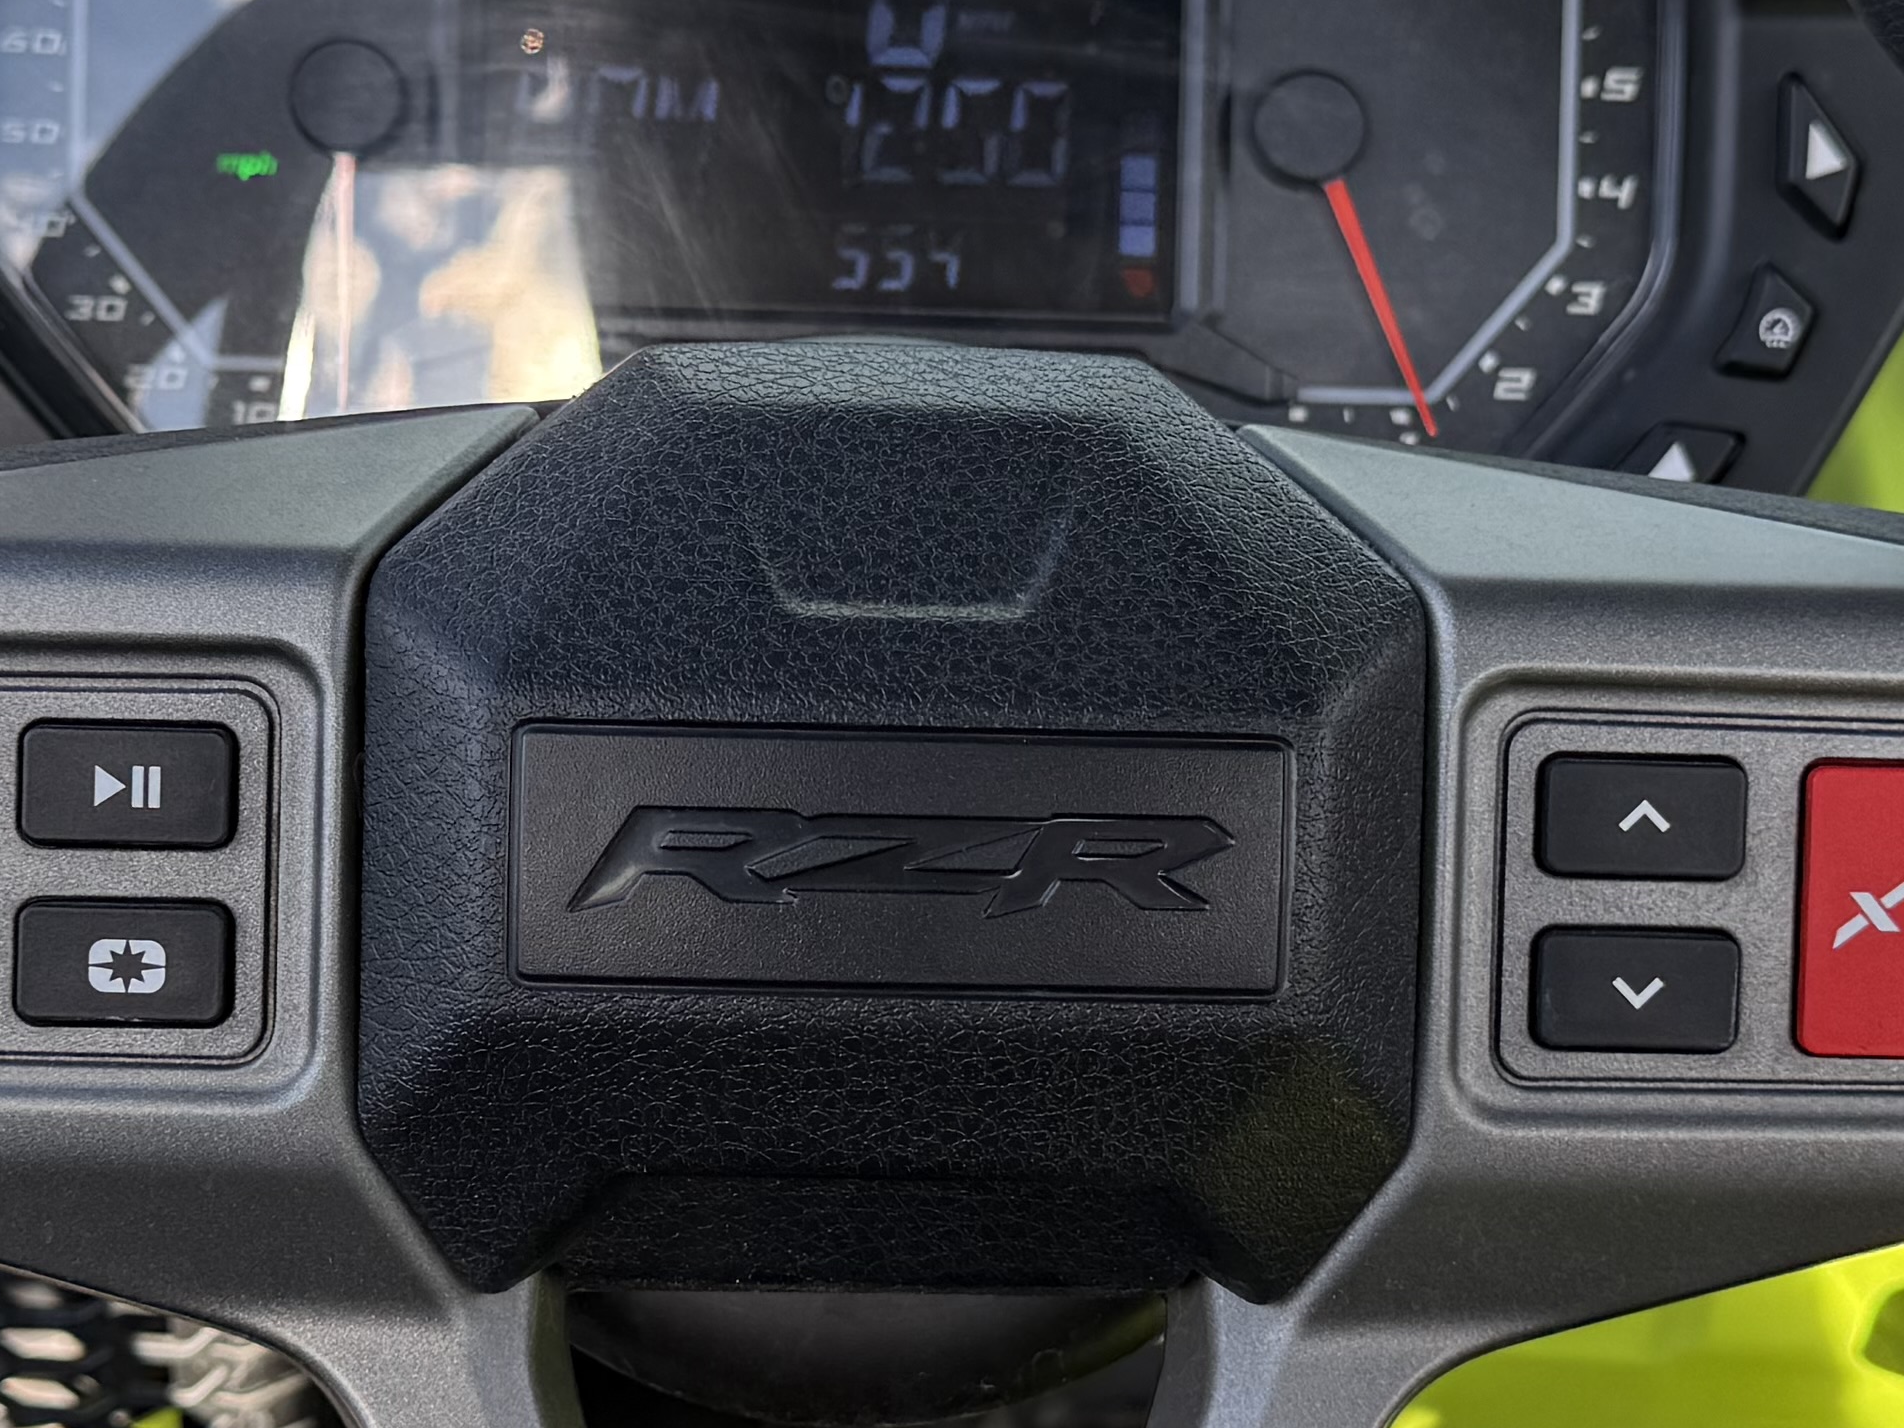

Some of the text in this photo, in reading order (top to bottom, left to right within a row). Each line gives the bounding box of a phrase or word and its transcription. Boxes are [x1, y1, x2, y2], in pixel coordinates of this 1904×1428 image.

[0, 27, 62, 55] 60
[1600, 66, 1644, 102] 5
[0, 118, 60, 145] 50
[1598, 174, 1639, 210] 4
[65, 294, 128, 322] 30
[1566, 281, 1606, 315] 3
[1493, 367, 1536, 401] 2
[568, 803, 1236, 919] RZR
